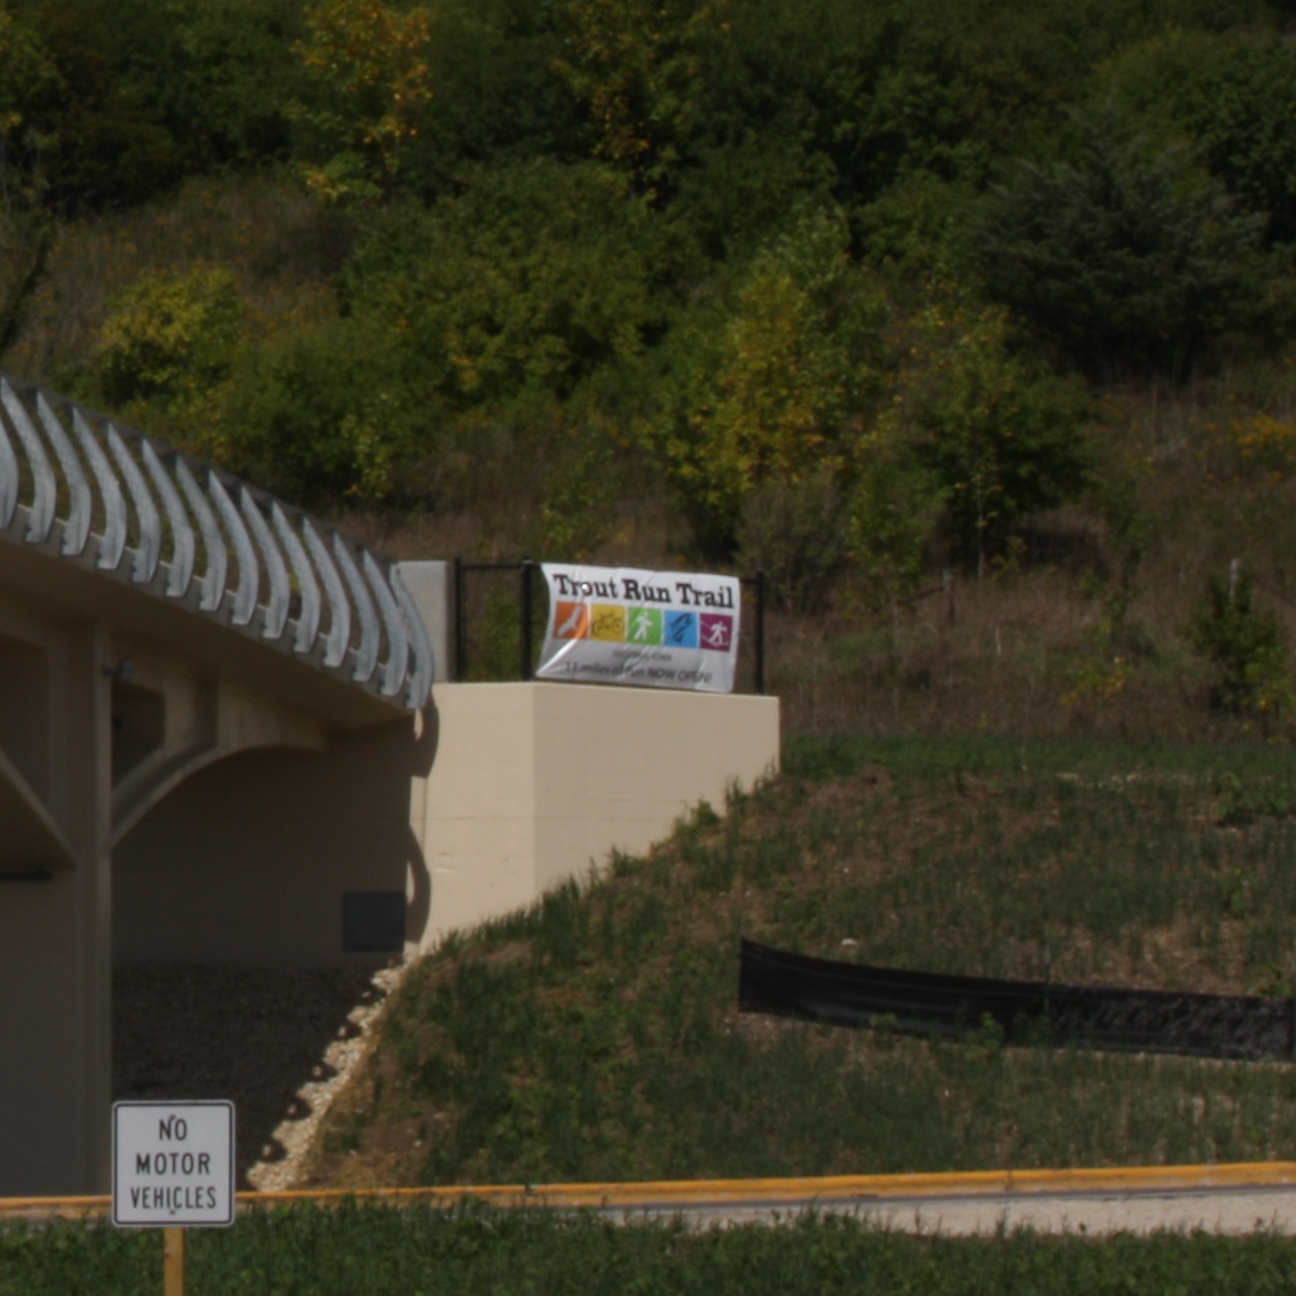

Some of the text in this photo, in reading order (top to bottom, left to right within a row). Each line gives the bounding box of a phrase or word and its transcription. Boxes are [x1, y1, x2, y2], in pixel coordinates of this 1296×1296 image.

[553, 574, 734, 608] Trout Run Trail
[648, 668, 675, 680] NOW
[159, 1119, 187, 1140] NO
[136, 1153, 210, 1175] MOTOR
[130, 1187, 216, 1209] VEHICLES
